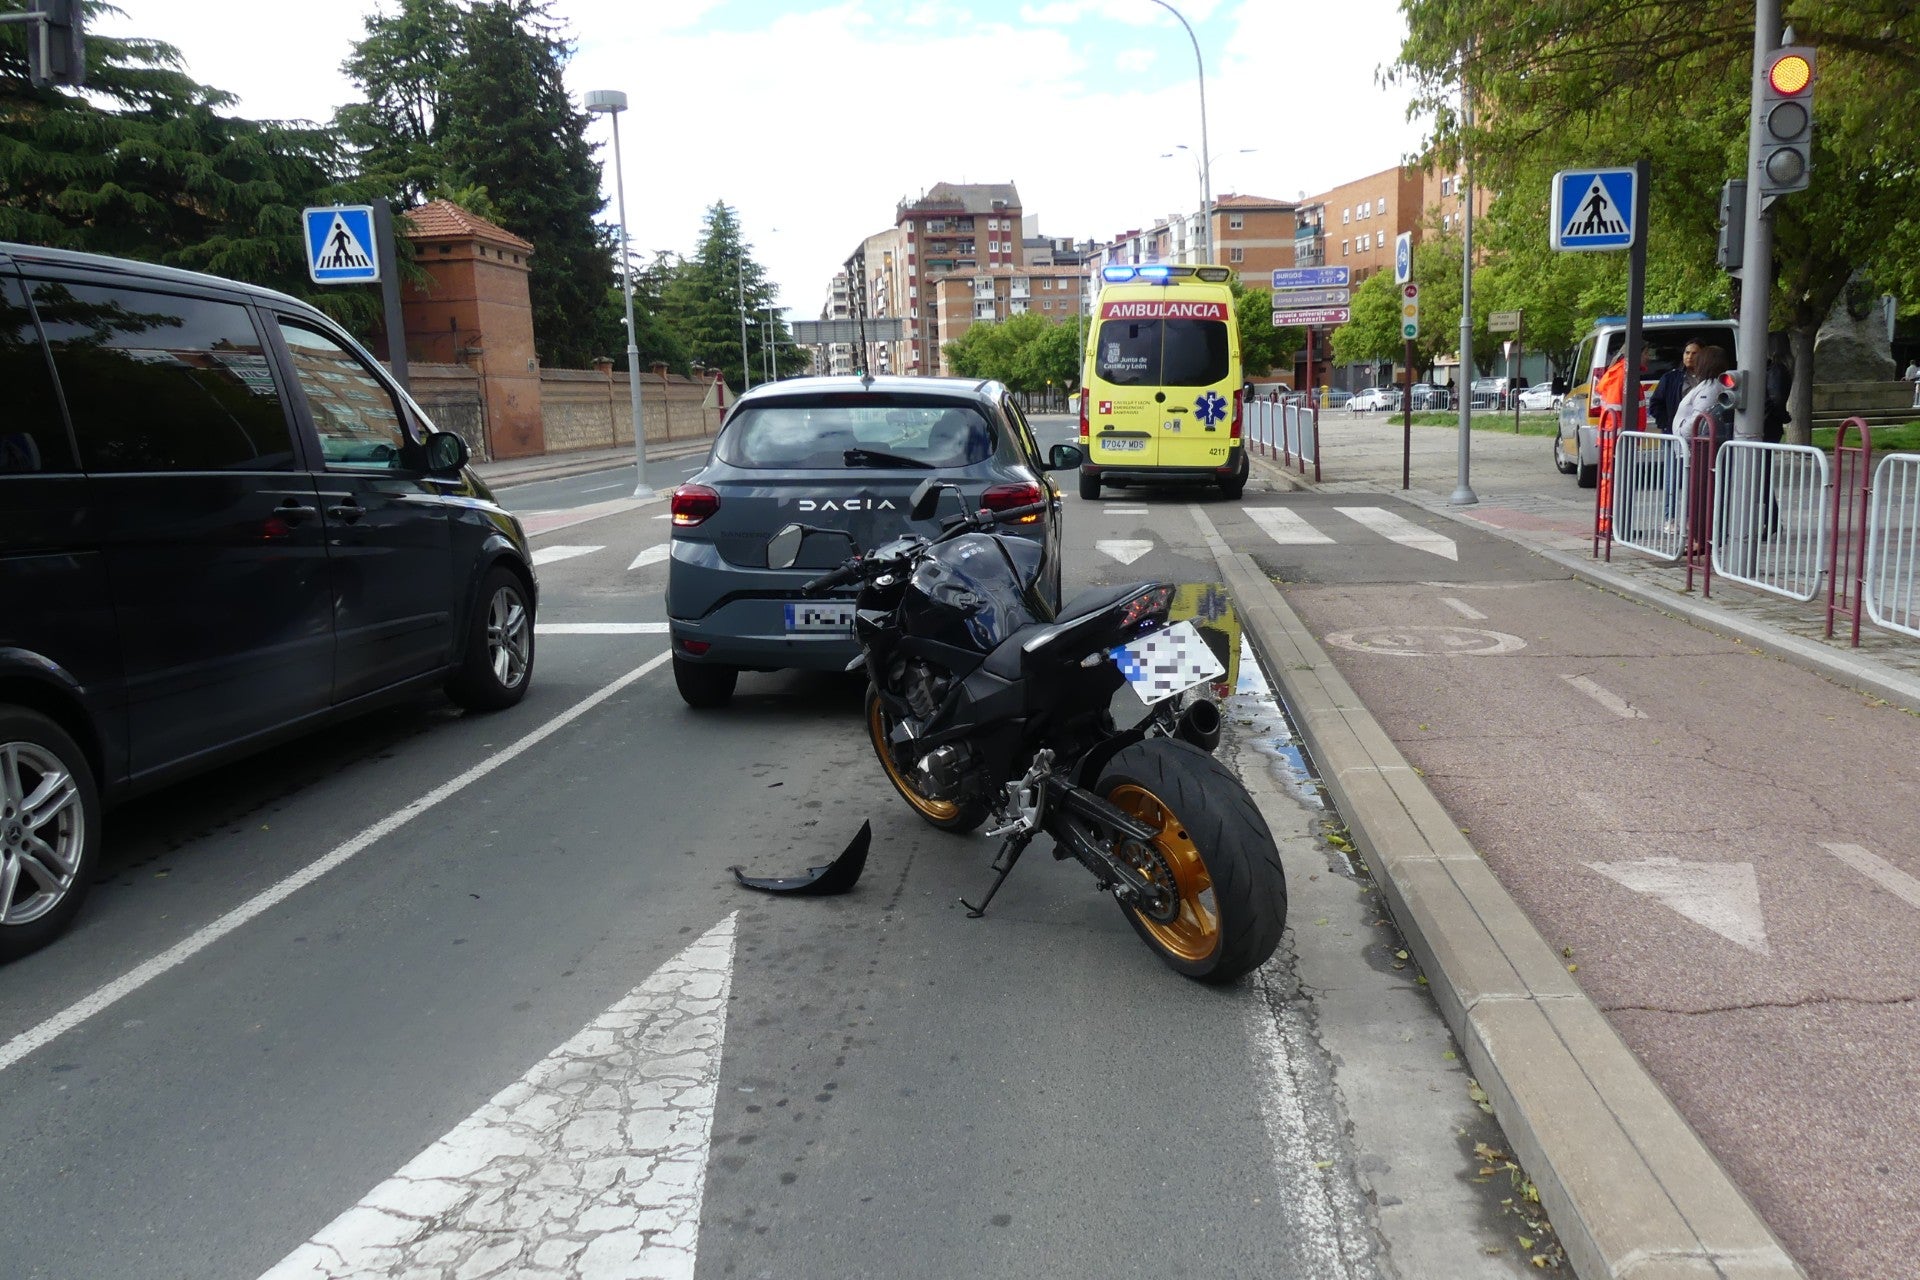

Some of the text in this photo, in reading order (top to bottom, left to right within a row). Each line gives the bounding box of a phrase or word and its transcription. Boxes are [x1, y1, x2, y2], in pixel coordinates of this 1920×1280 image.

[1109, 304, 1221, 317] AMBULANCIA
[1298, 310, 1335, 318] universitaria
[1106, 440, 1144, 448] 7047 MDS
[1209, 448, 1226, 456] 4211
[799, 499, 896, 511] DACIA
